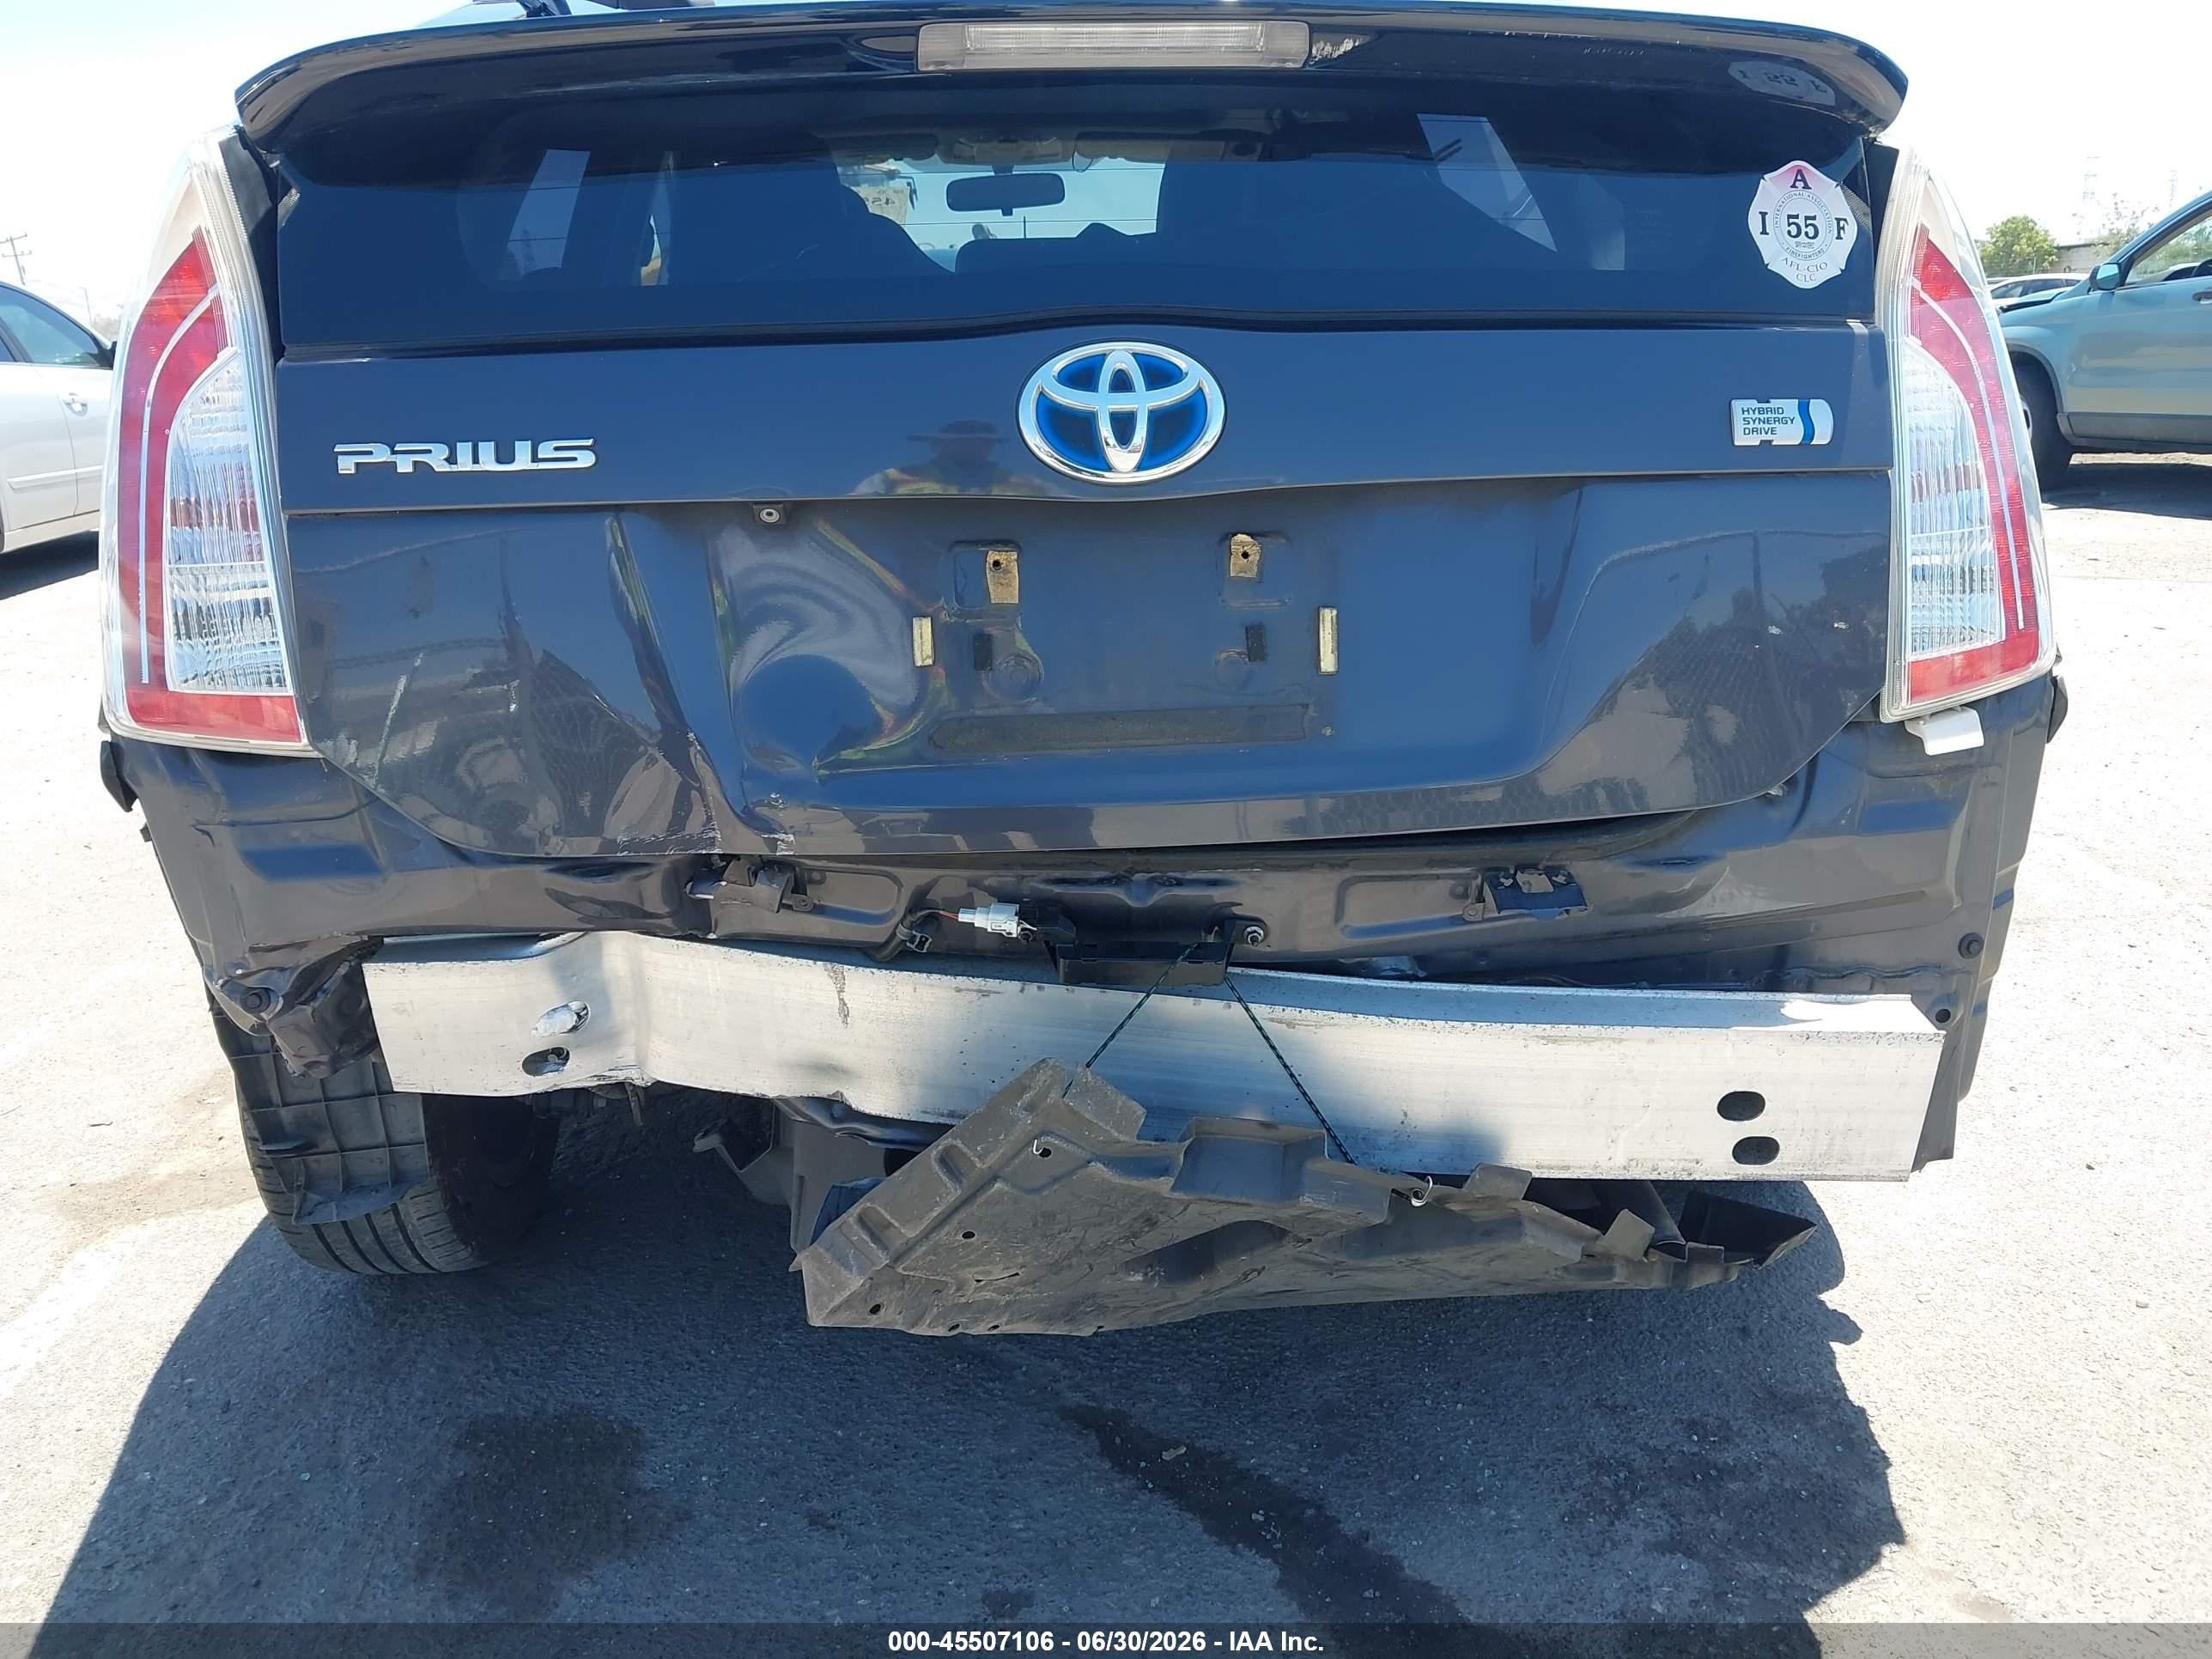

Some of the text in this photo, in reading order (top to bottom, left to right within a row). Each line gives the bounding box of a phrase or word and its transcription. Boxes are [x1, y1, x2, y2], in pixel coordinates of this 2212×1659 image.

[1790, 168, 1812, 190] A
[1759, 211, 1770, 235] I
[1774, 192, 1833, 234] INTERNATIONAL ASSOCIATION
[1786, 213, 1820, 240] 55
[1833, 217, 1849, 240] F
[1781, 257, 1828, 273] AFL-CIO
[1796, 273, 1817, 283] CLC
[1741, 406, 1784, 416] HYBRID
[1742, 416, 1796, 425] SYNERGY
[1743, 427, 1778, 435] DRIVE
[333, 438, 597, 474] PRIUS
